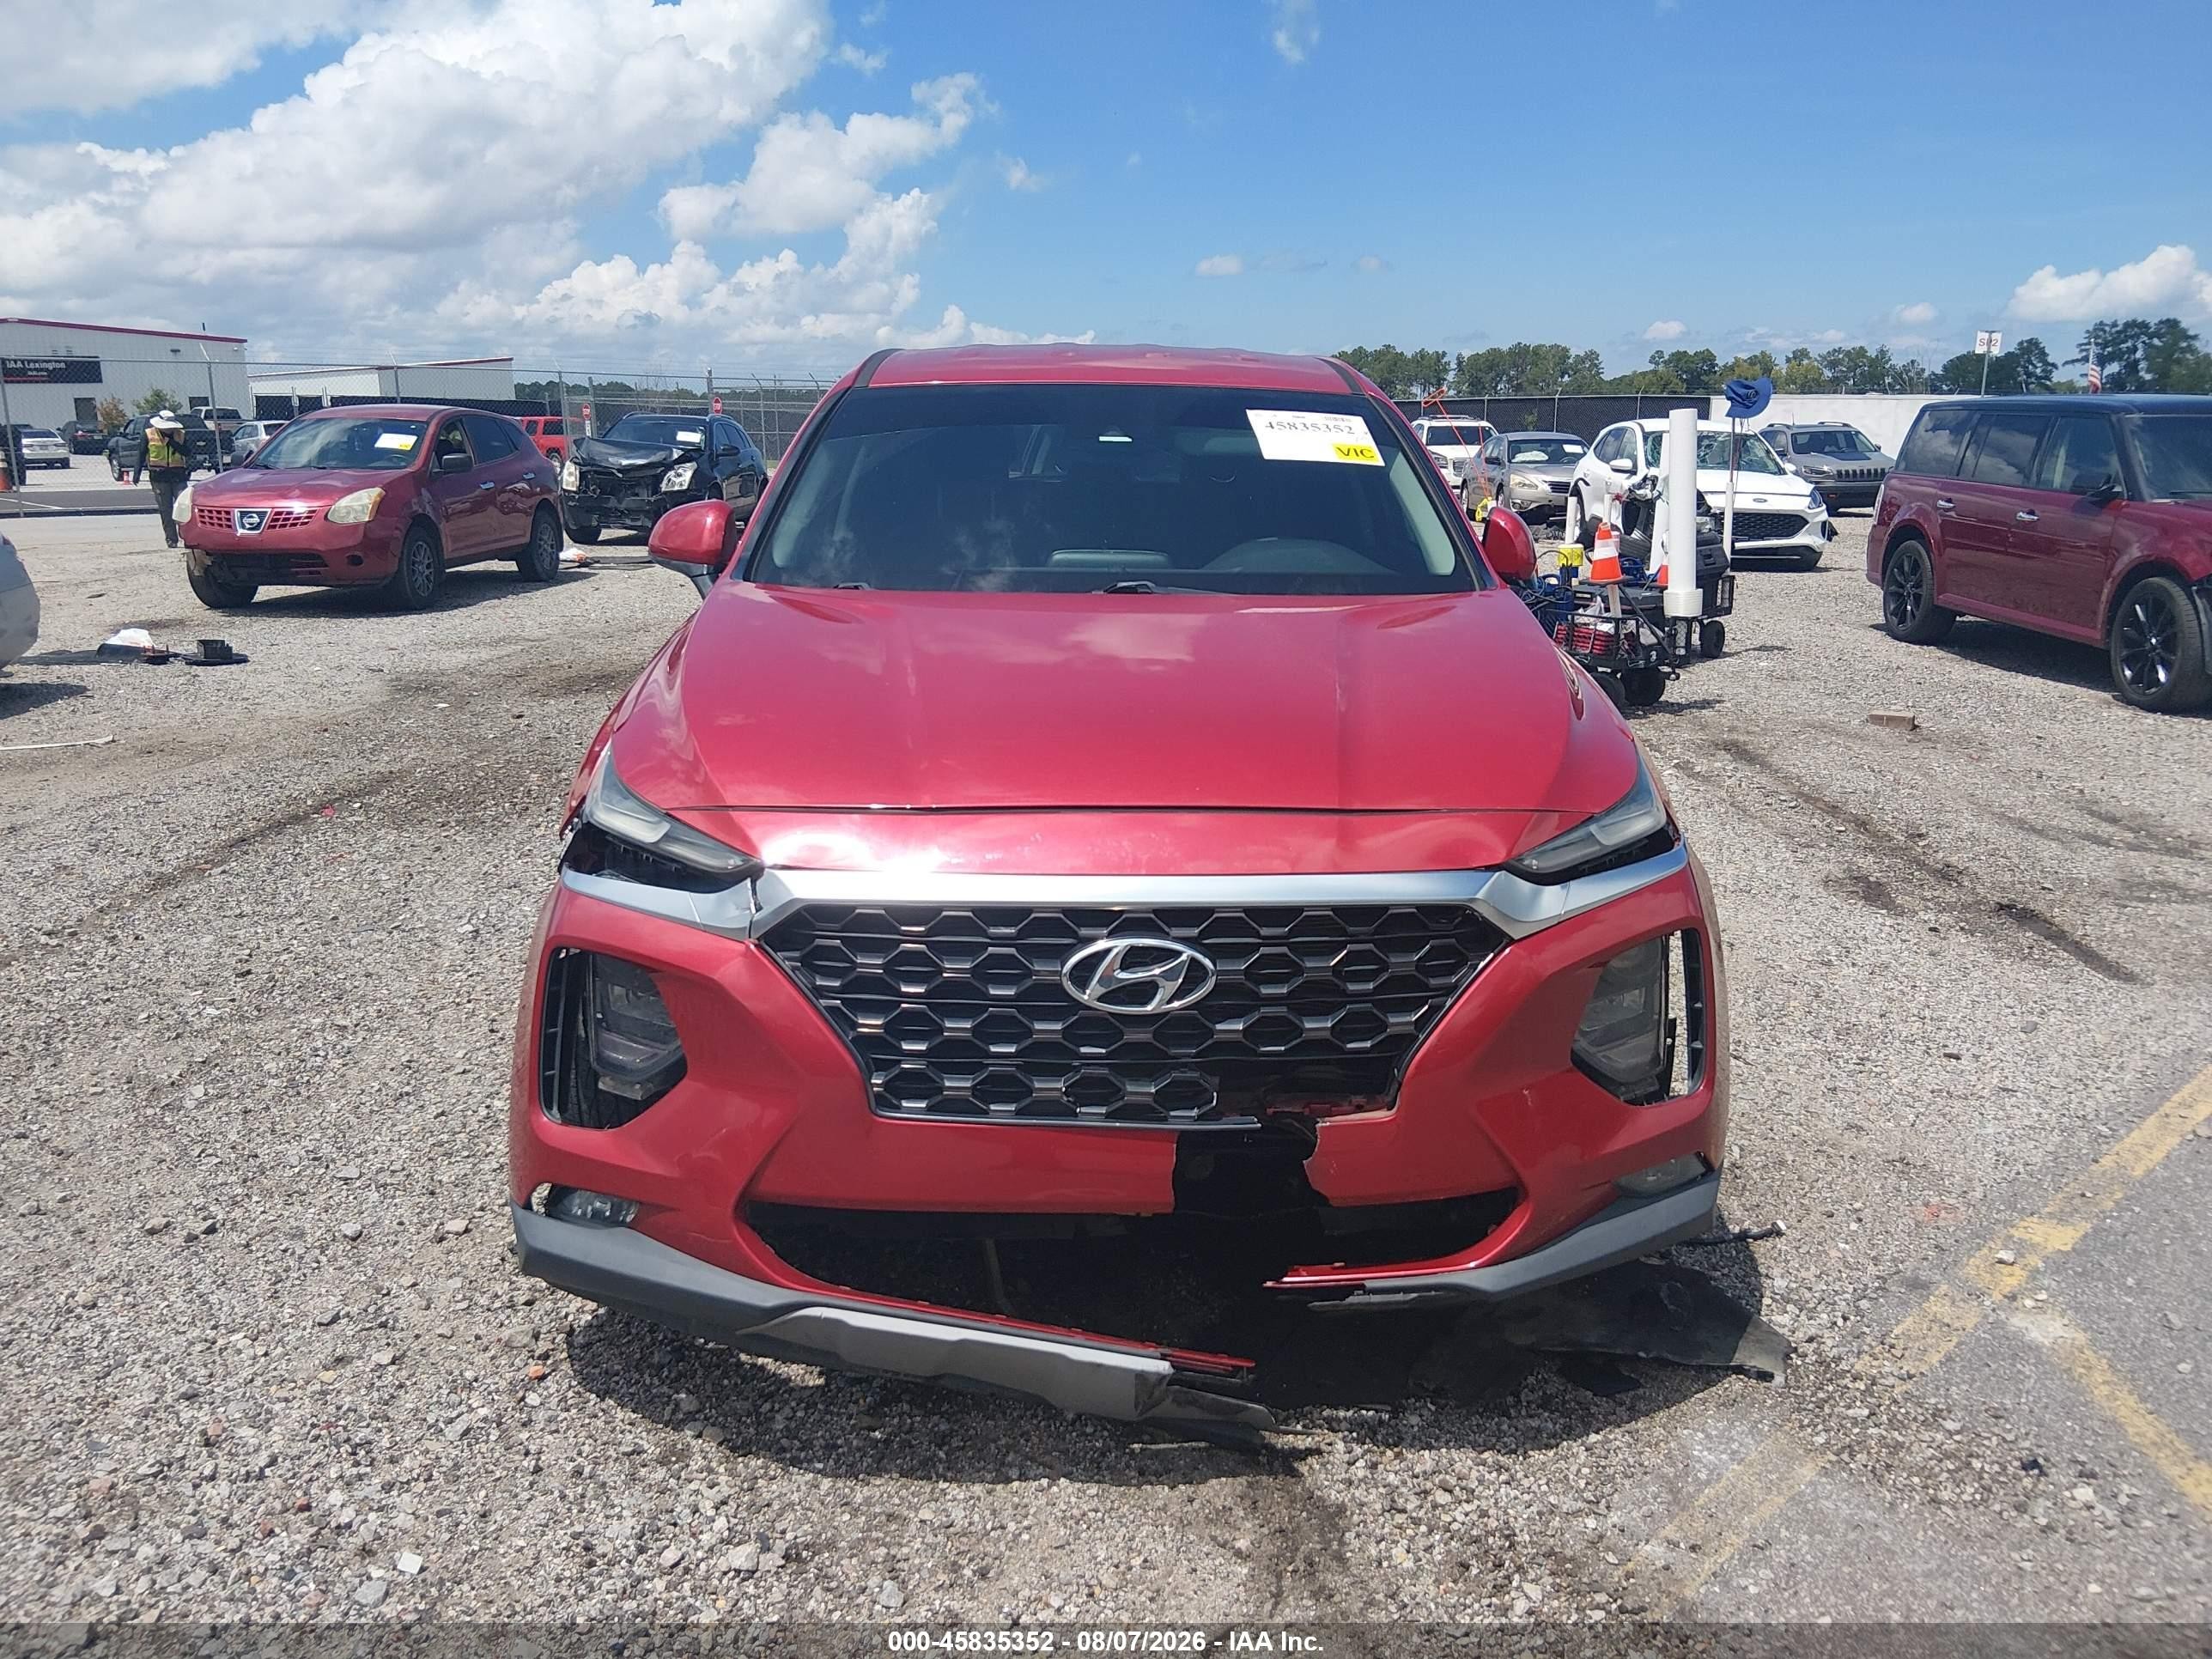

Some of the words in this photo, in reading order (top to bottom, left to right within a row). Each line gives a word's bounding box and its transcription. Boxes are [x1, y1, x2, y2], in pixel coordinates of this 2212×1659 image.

[24, 361, 66, 370] Lexington
[1265, 422, 1355, 434] 45835352
[1336, 447, 1375, 459] VIC
